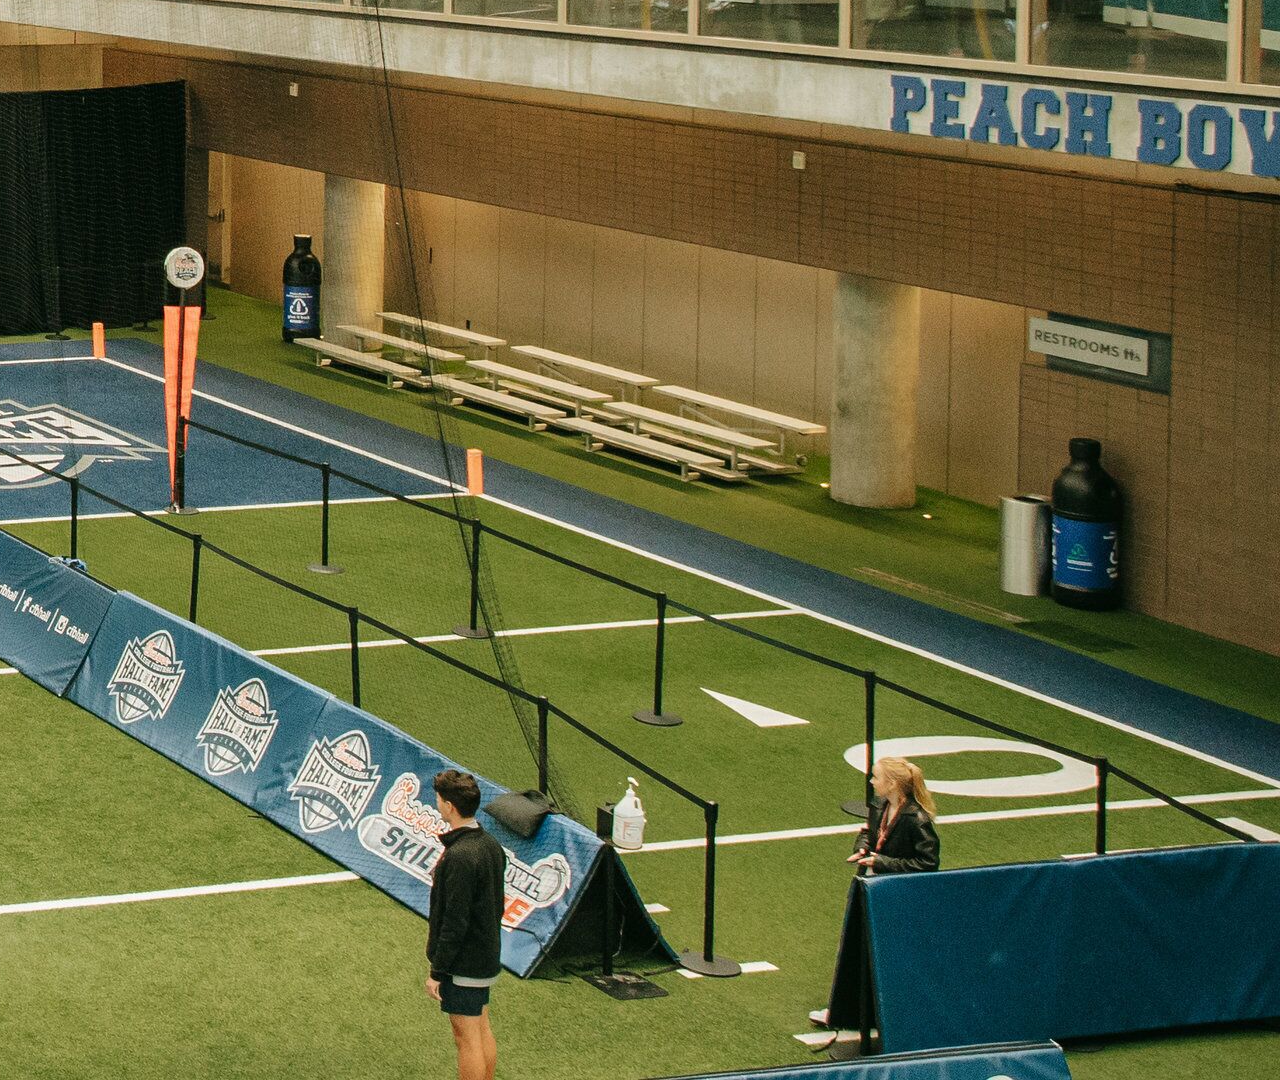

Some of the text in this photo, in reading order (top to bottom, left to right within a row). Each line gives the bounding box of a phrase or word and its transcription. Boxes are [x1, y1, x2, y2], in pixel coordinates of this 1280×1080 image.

[890, 74, 1113, 158] PEACH
[1034, 329, 1120, 357] RESTROOMS
[28, 603, 52, 622] cfbhall
[66, 625, 90, 645] cfbhall
[119, 655, 144, 682] HALL
[147, 674, 175, 702] FAME
[209, 705, 236, 733] HALL
[239, 726, 268, 755] FAME
[302, 756, 333, 788] HALL
[337, 780, 369, 812] FAME
[381, 826, 437, 871] SKIL
[505, 855, 541, 901] OWL
